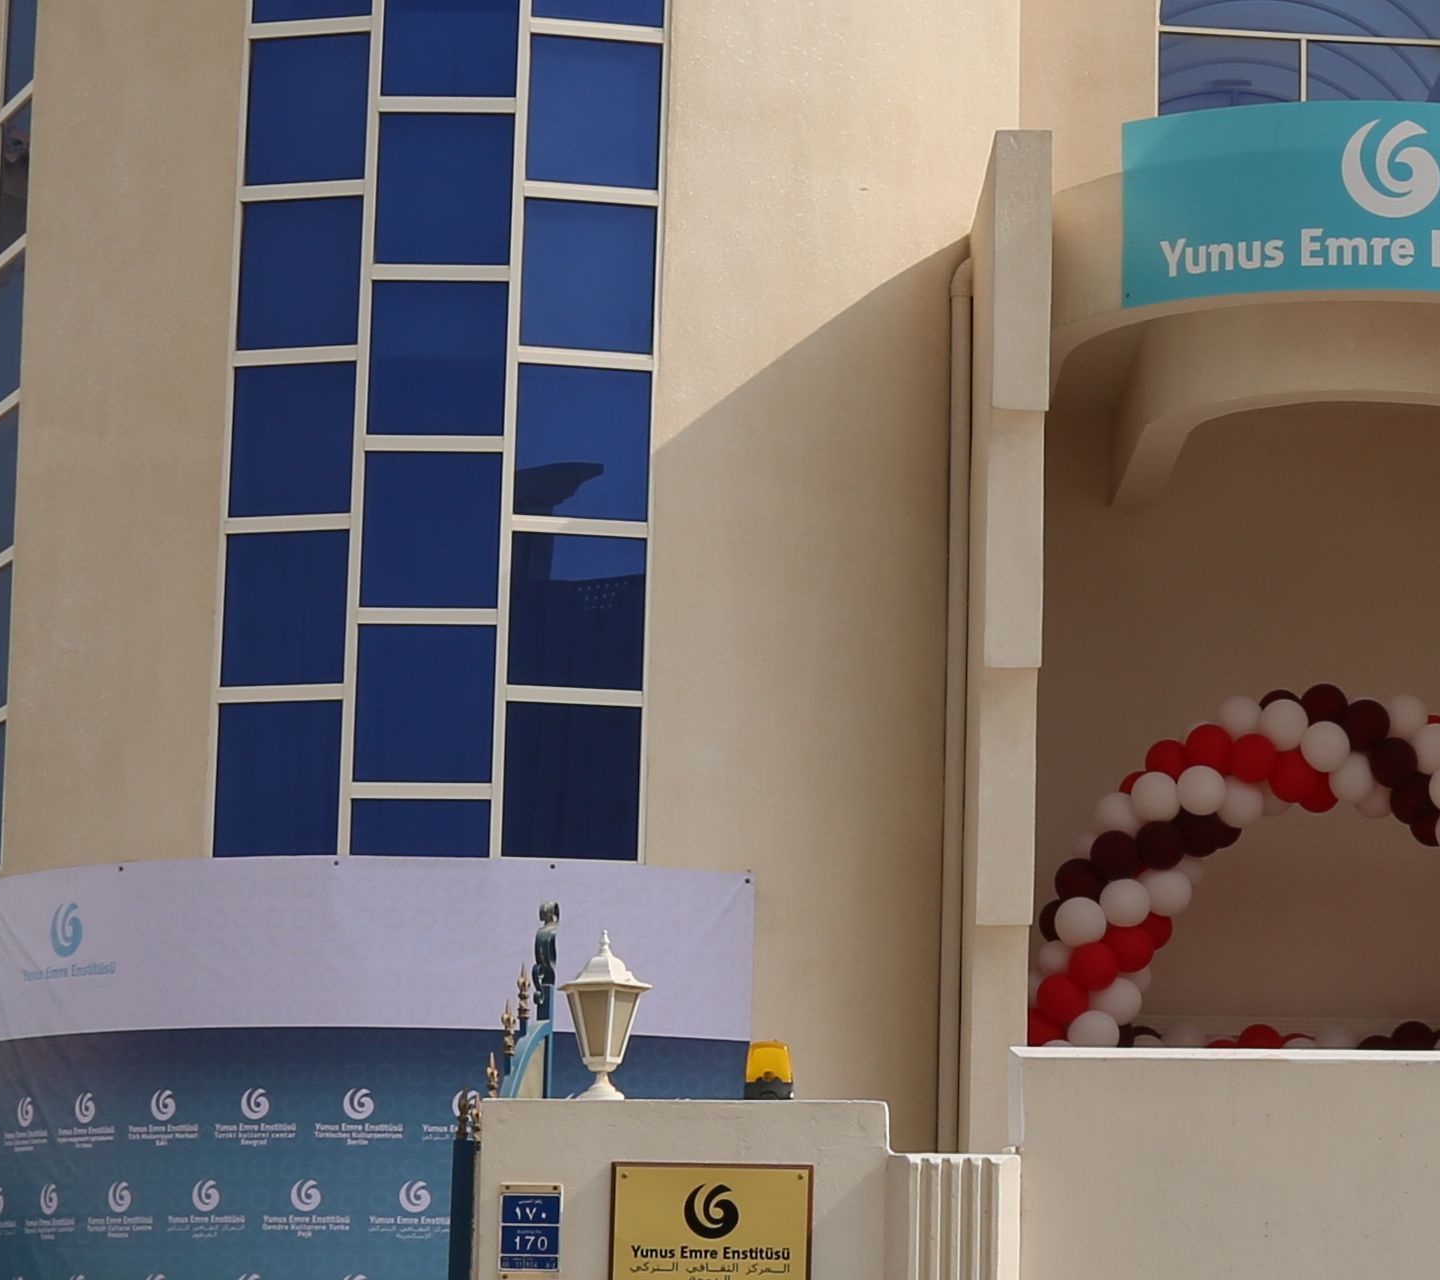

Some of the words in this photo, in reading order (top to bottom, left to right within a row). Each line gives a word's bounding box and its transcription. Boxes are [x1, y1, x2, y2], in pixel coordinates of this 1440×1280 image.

[1160, 238, 1284, 277] Yunus
[1300, 228, 1415, 267] Emre
[314, 1122, 339, 1131] Yunus
[341, 1122, 362, 1131] Emre
[369, 1216, 394, 1224] Yunus
[396, 1216, 418, 1224] Emre
[515, 1206, 547, 1220] ١٧٠
[514, 1236, 548, 1251] 170
[631, 1244, 676, 1259] Yunus
[680, 1245, 718, 1260] Emre
[722, 1246, 790, 1261] Enstitüsü
